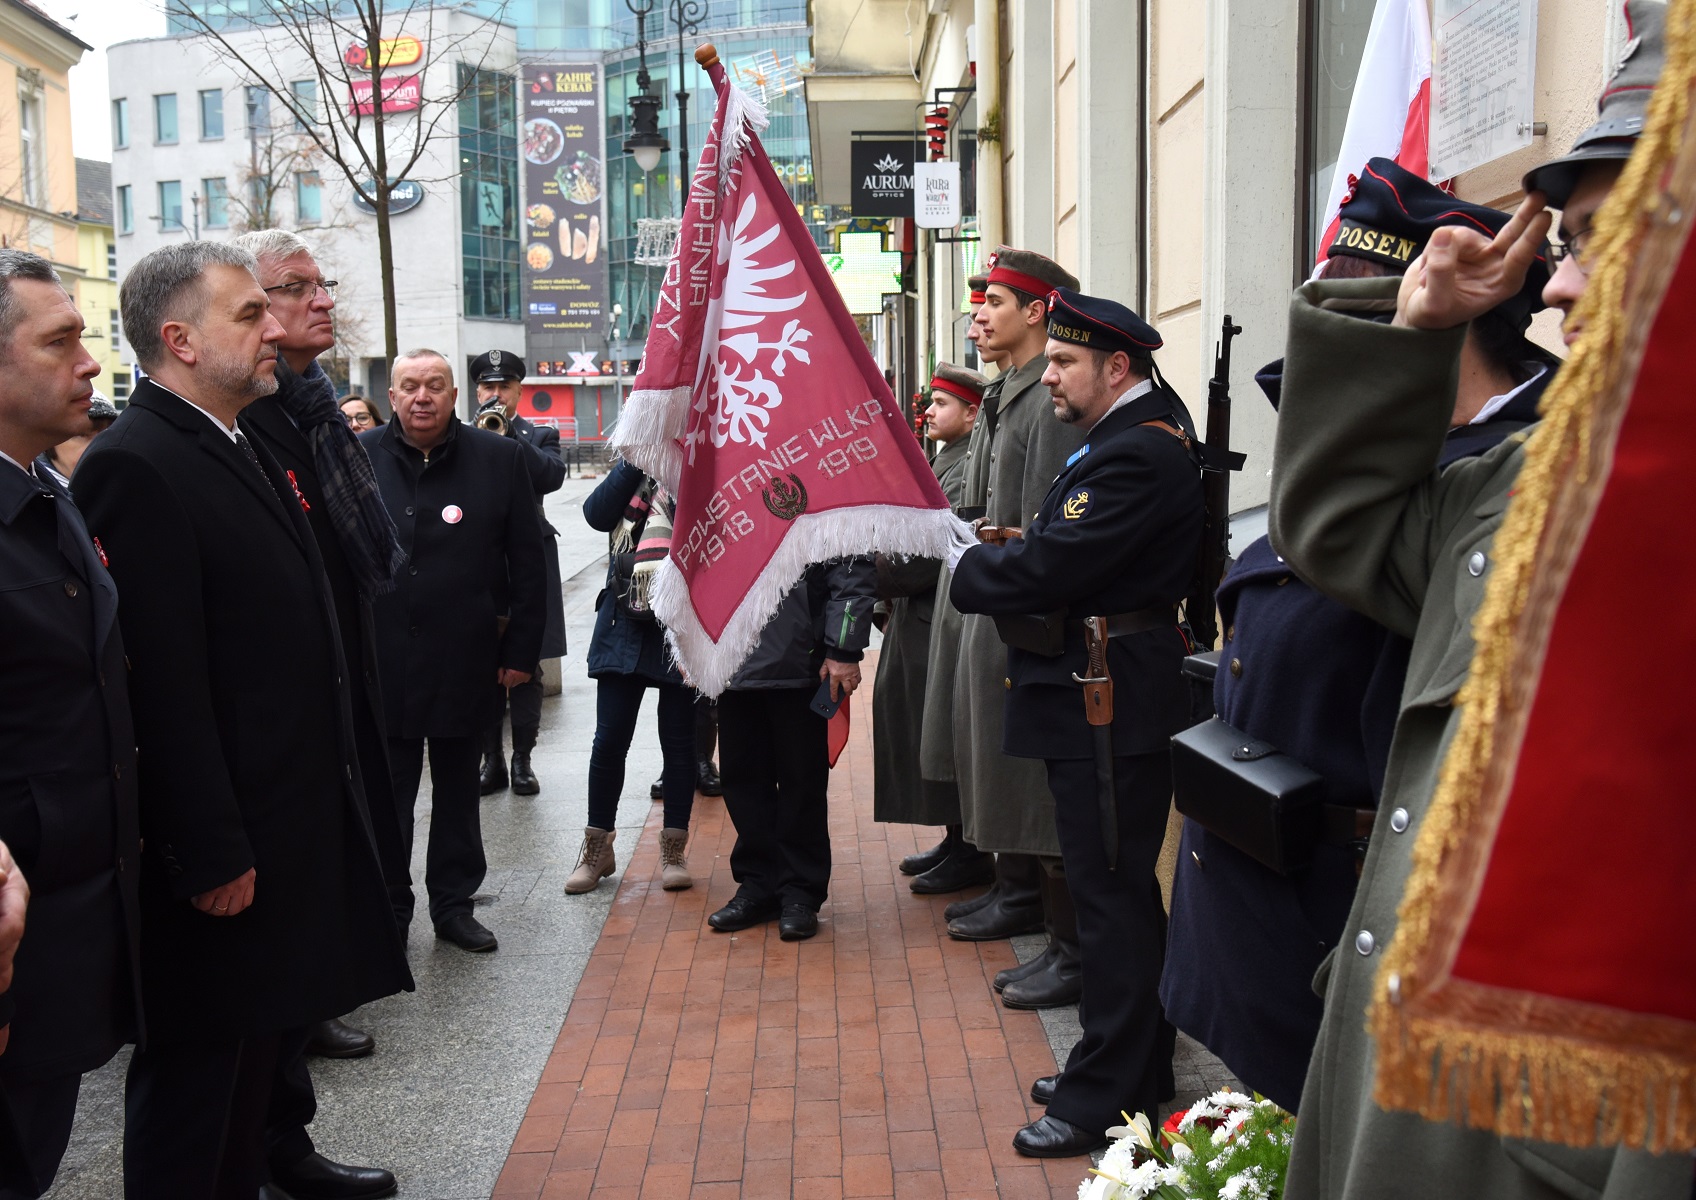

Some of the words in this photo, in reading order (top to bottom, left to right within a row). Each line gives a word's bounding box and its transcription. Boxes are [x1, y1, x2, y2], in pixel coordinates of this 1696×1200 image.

[556, 72, 592, 82] ZAHIR
[556, 83, 593, 93] KEBAB
[862, 175, 914, 190] AURUM
[1334, 226, 1417, 262] POSEN
[1051, 323, 1092, 343] POSEN
[676, 434, 809, 570] POWSTANIE
[698, 510, 755, 568] 1918
[816, 436, 879, 479] 1919
